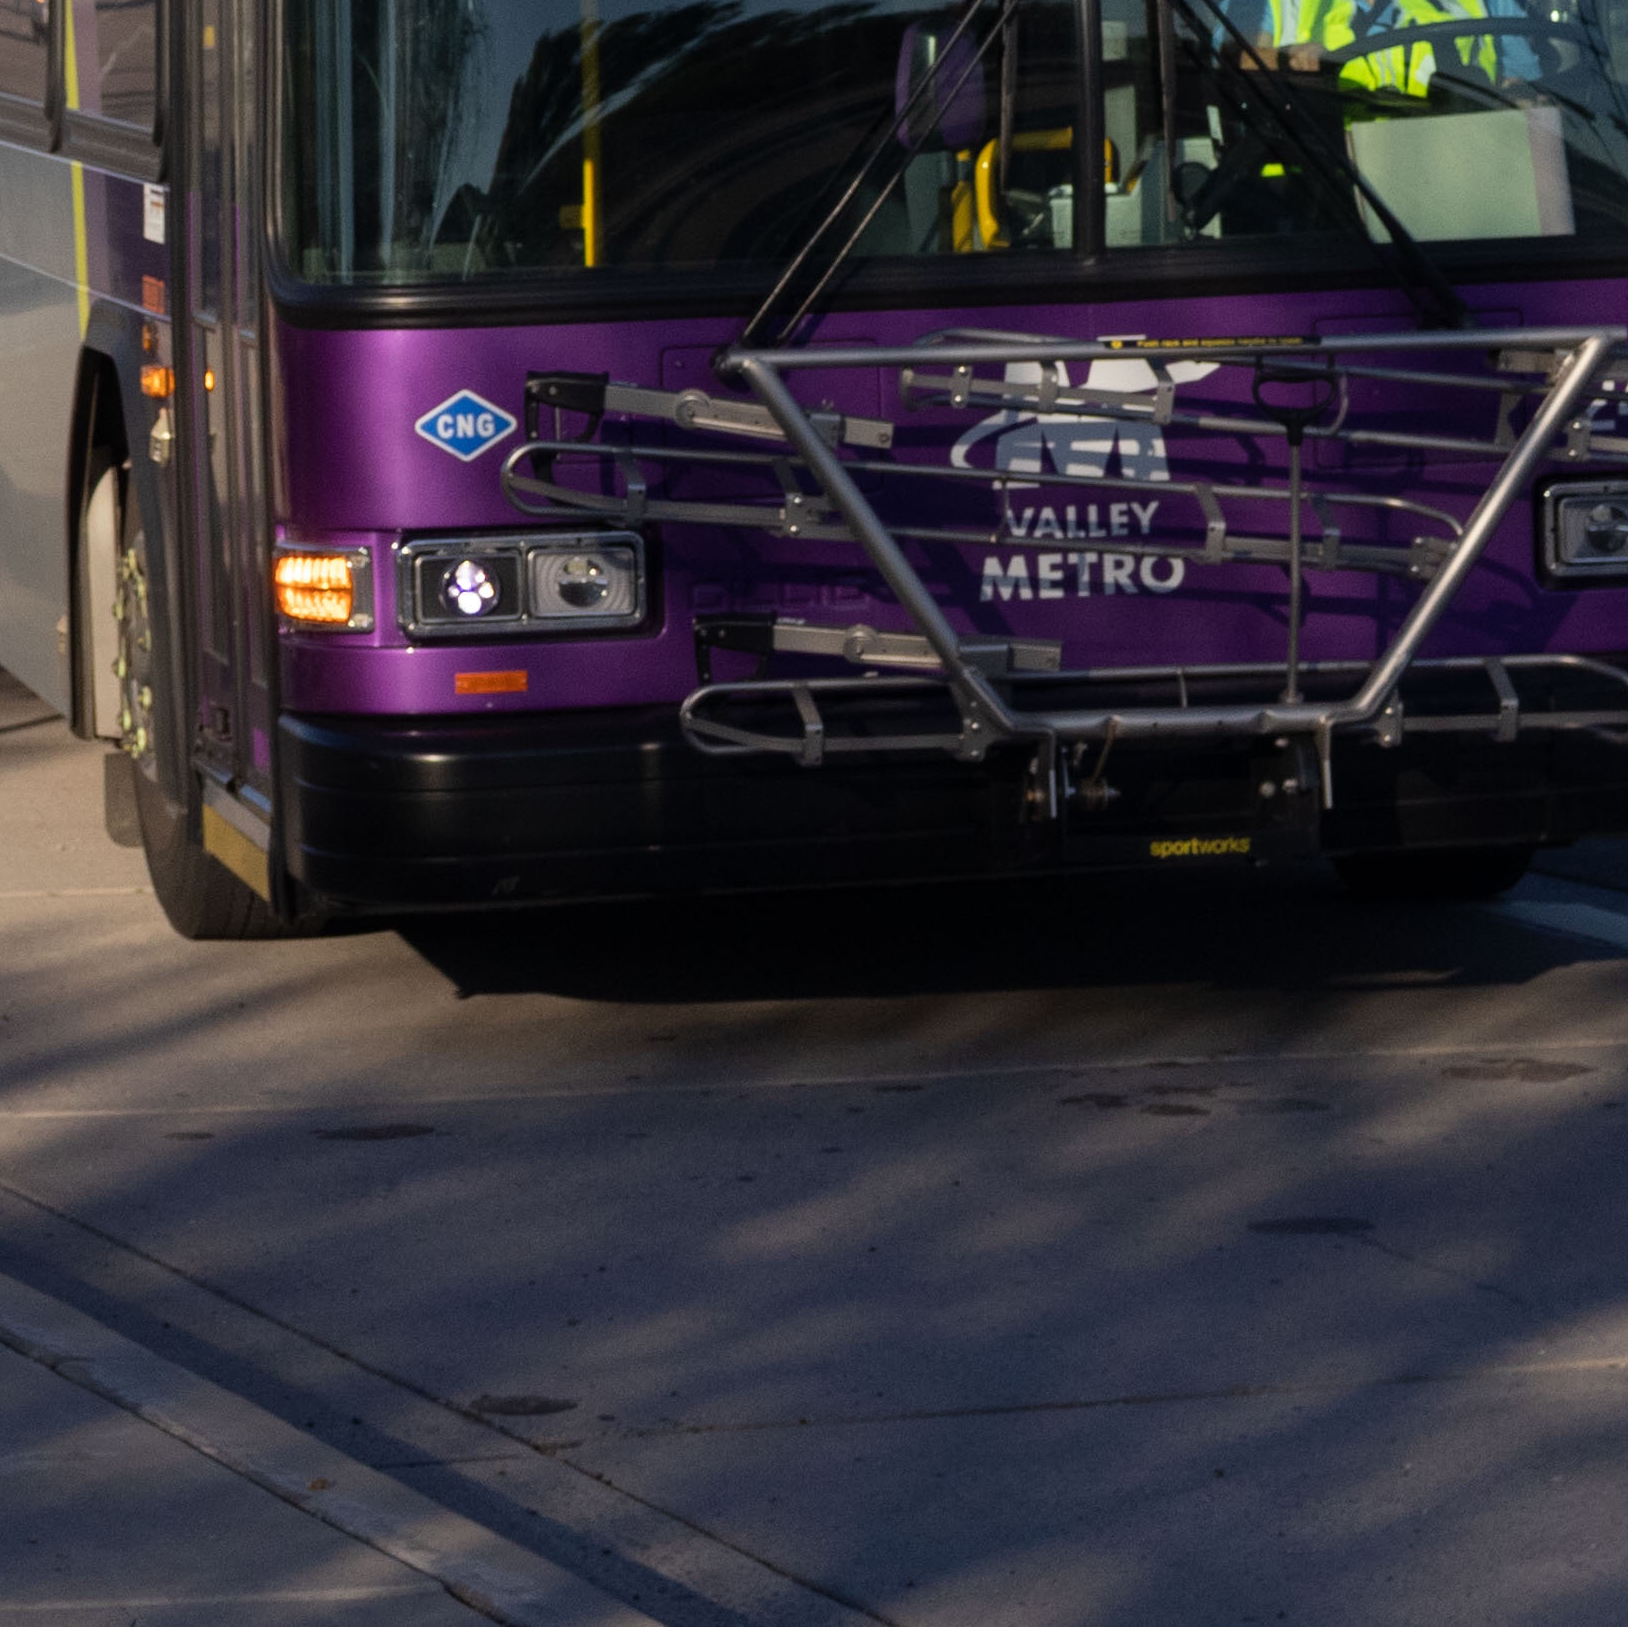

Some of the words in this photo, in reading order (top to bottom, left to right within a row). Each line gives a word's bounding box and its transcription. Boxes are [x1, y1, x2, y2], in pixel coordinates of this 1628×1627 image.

[436, 412, 495, 439] CNG
[1006, 500, 1159, 539] VALLEY
[979, 552, 1185, 603] METRO
[1150, 836, 1251, 859] sportworks
